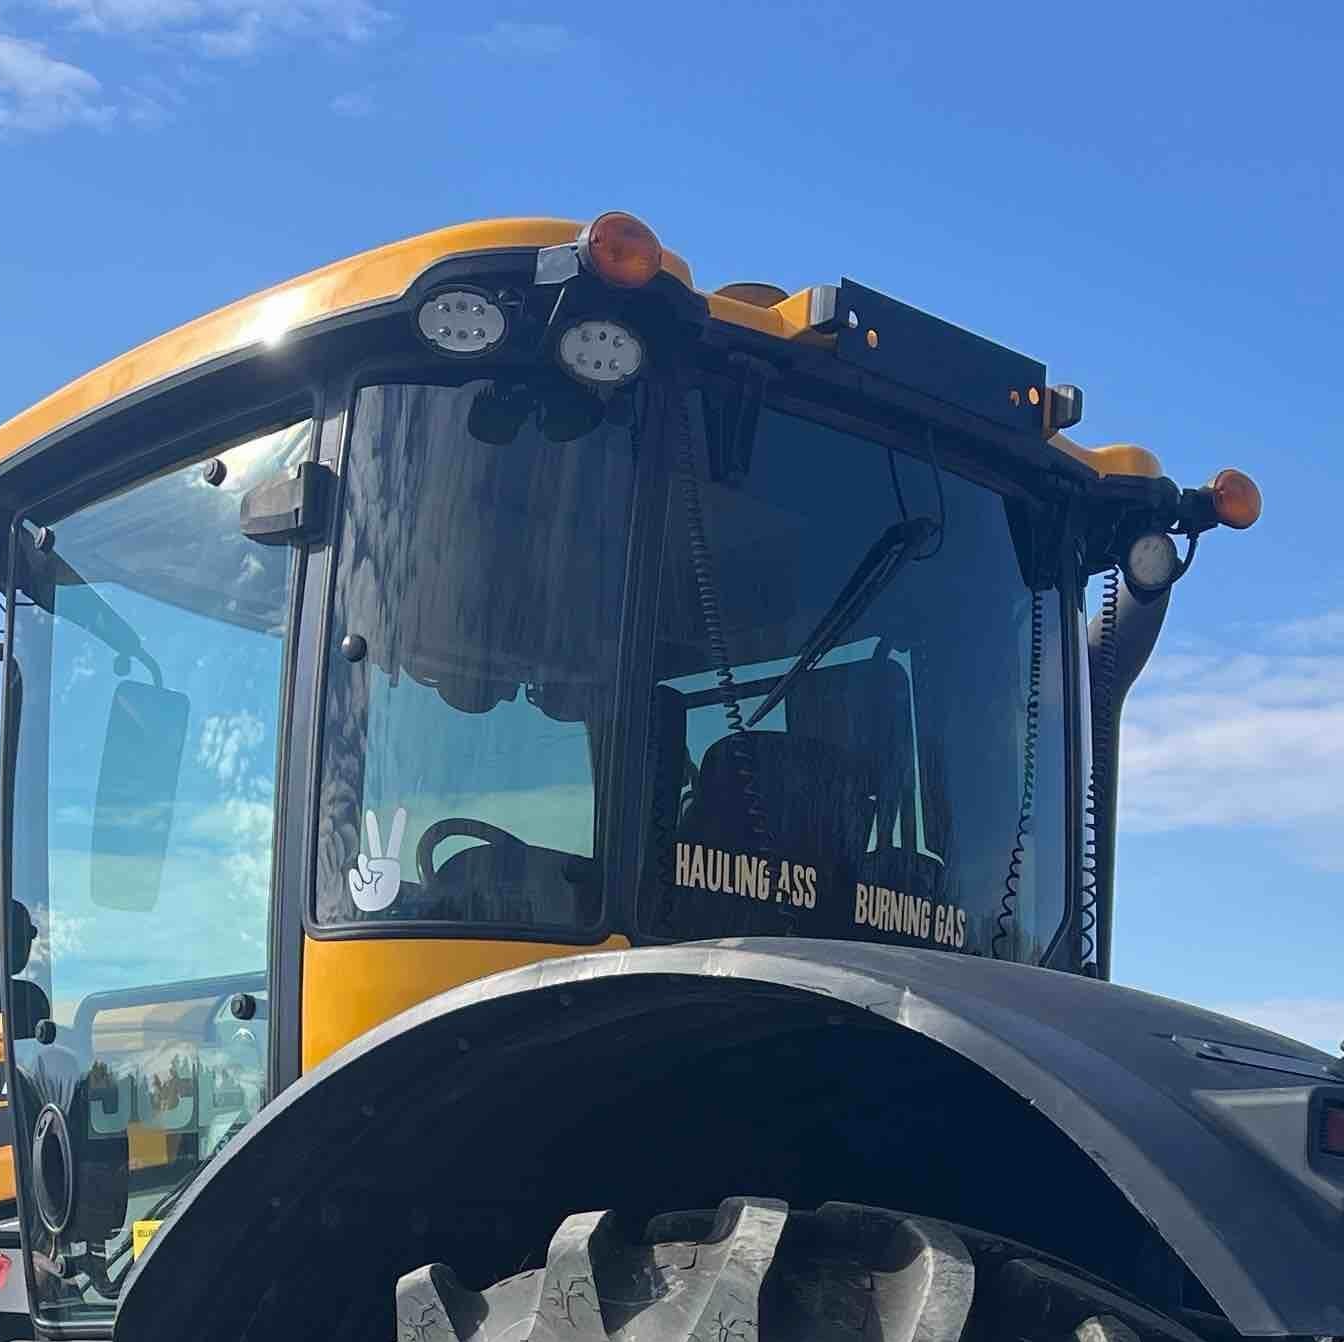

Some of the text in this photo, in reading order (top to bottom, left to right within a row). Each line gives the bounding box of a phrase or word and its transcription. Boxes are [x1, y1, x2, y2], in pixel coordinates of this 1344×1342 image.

[674, 842, 817, 909] HAULING ASS
[856, 883, 966, 948] BURNING GAS
